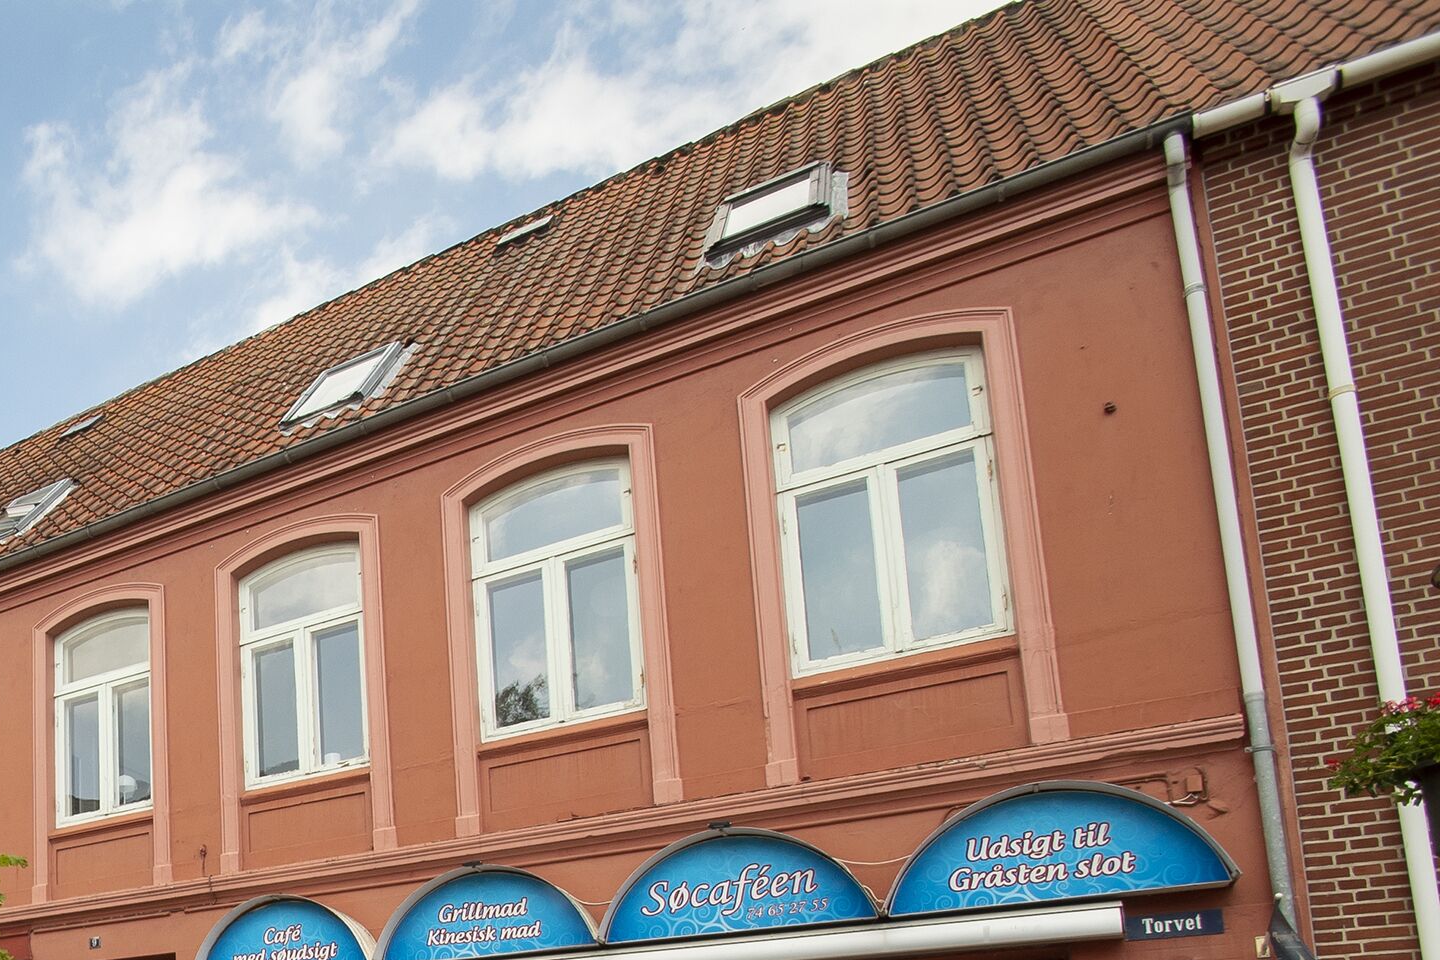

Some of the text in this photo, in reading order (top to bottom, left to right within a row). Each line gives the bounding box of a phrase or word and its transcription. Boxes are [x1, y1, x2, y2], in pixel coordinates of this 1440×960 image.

[965, 822, 1111, 861] Udsigt til
[948, 851, 1137, 892] Gråsten slot
[641, 863, 818, 917] Søcaféen
[438, 897, 528, 923] Grillmad
[747, 897, 828, 920] 74 65 27 55
[263, 923, 303, 945] Café
[427, 921, 541, 948] Kinesisk mad
[1141, 914, 1202, 934] Torvet
